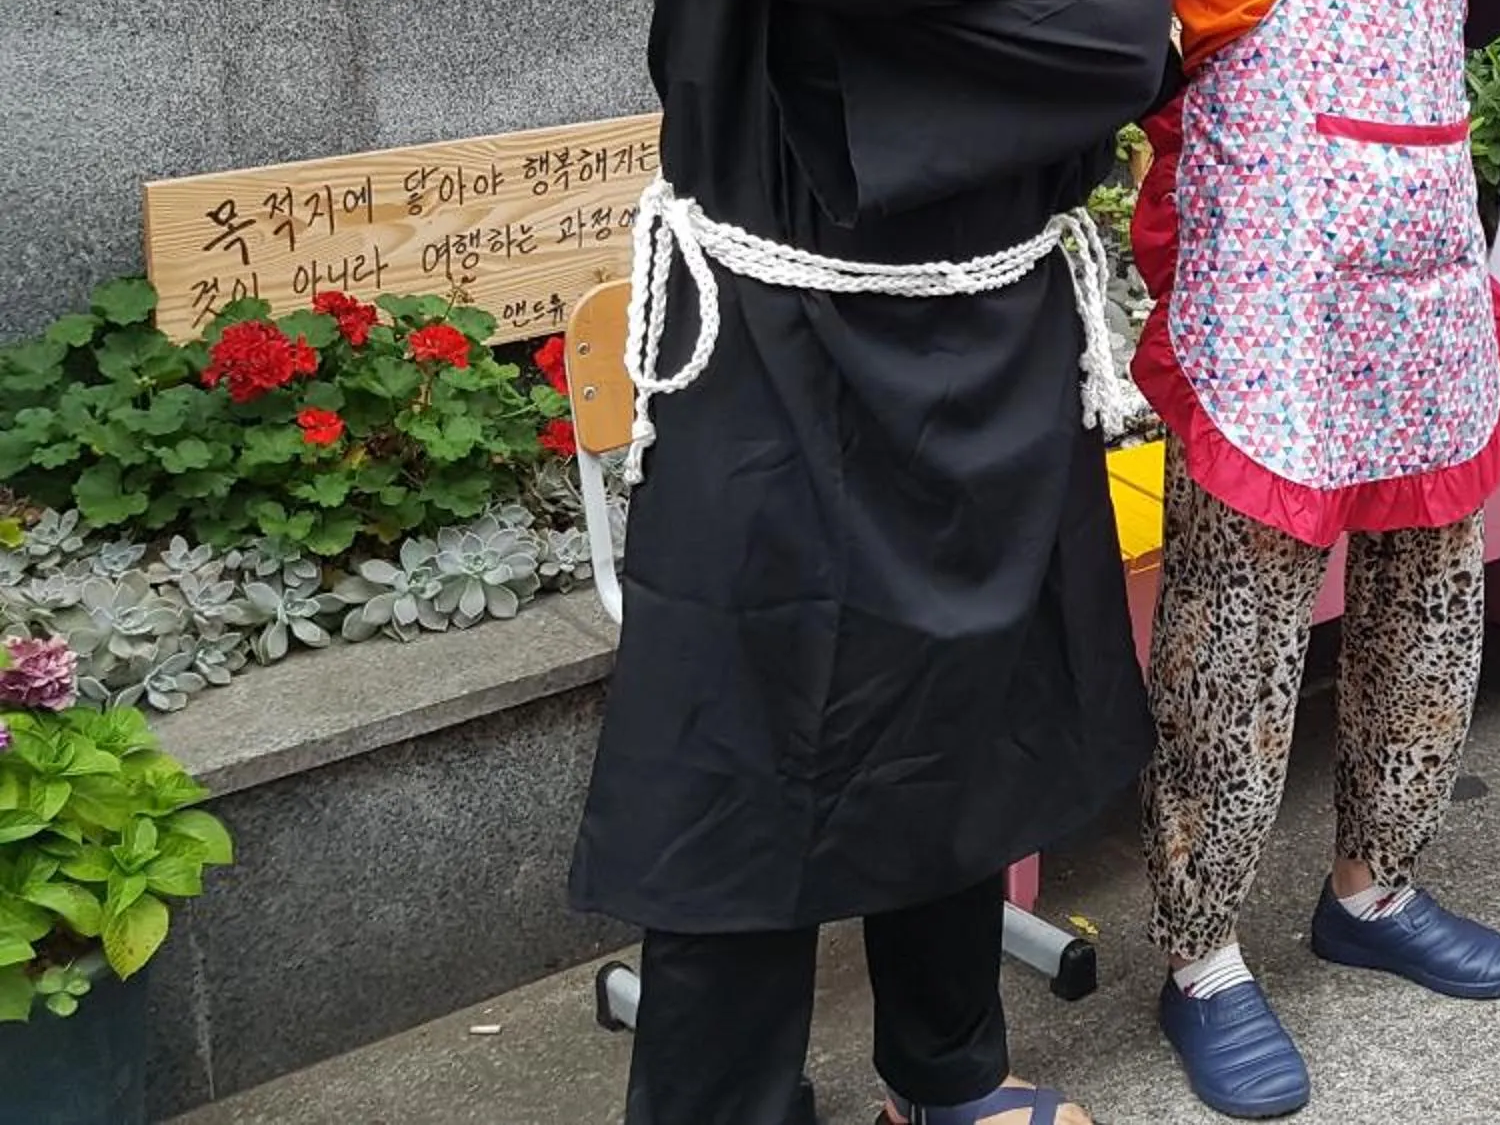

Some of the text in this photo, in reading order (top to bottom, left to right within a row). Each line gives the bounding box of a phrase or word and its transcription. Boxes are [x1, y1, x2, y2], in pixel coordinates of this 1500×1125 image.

[202, 143, 660, 266] 목적지에 닿아야 행복해지는
[293, 245, 390, 302] 아니라
[422, 224, 539, 279] 여행하는
[503, 293, 567, 327] 앤드류
